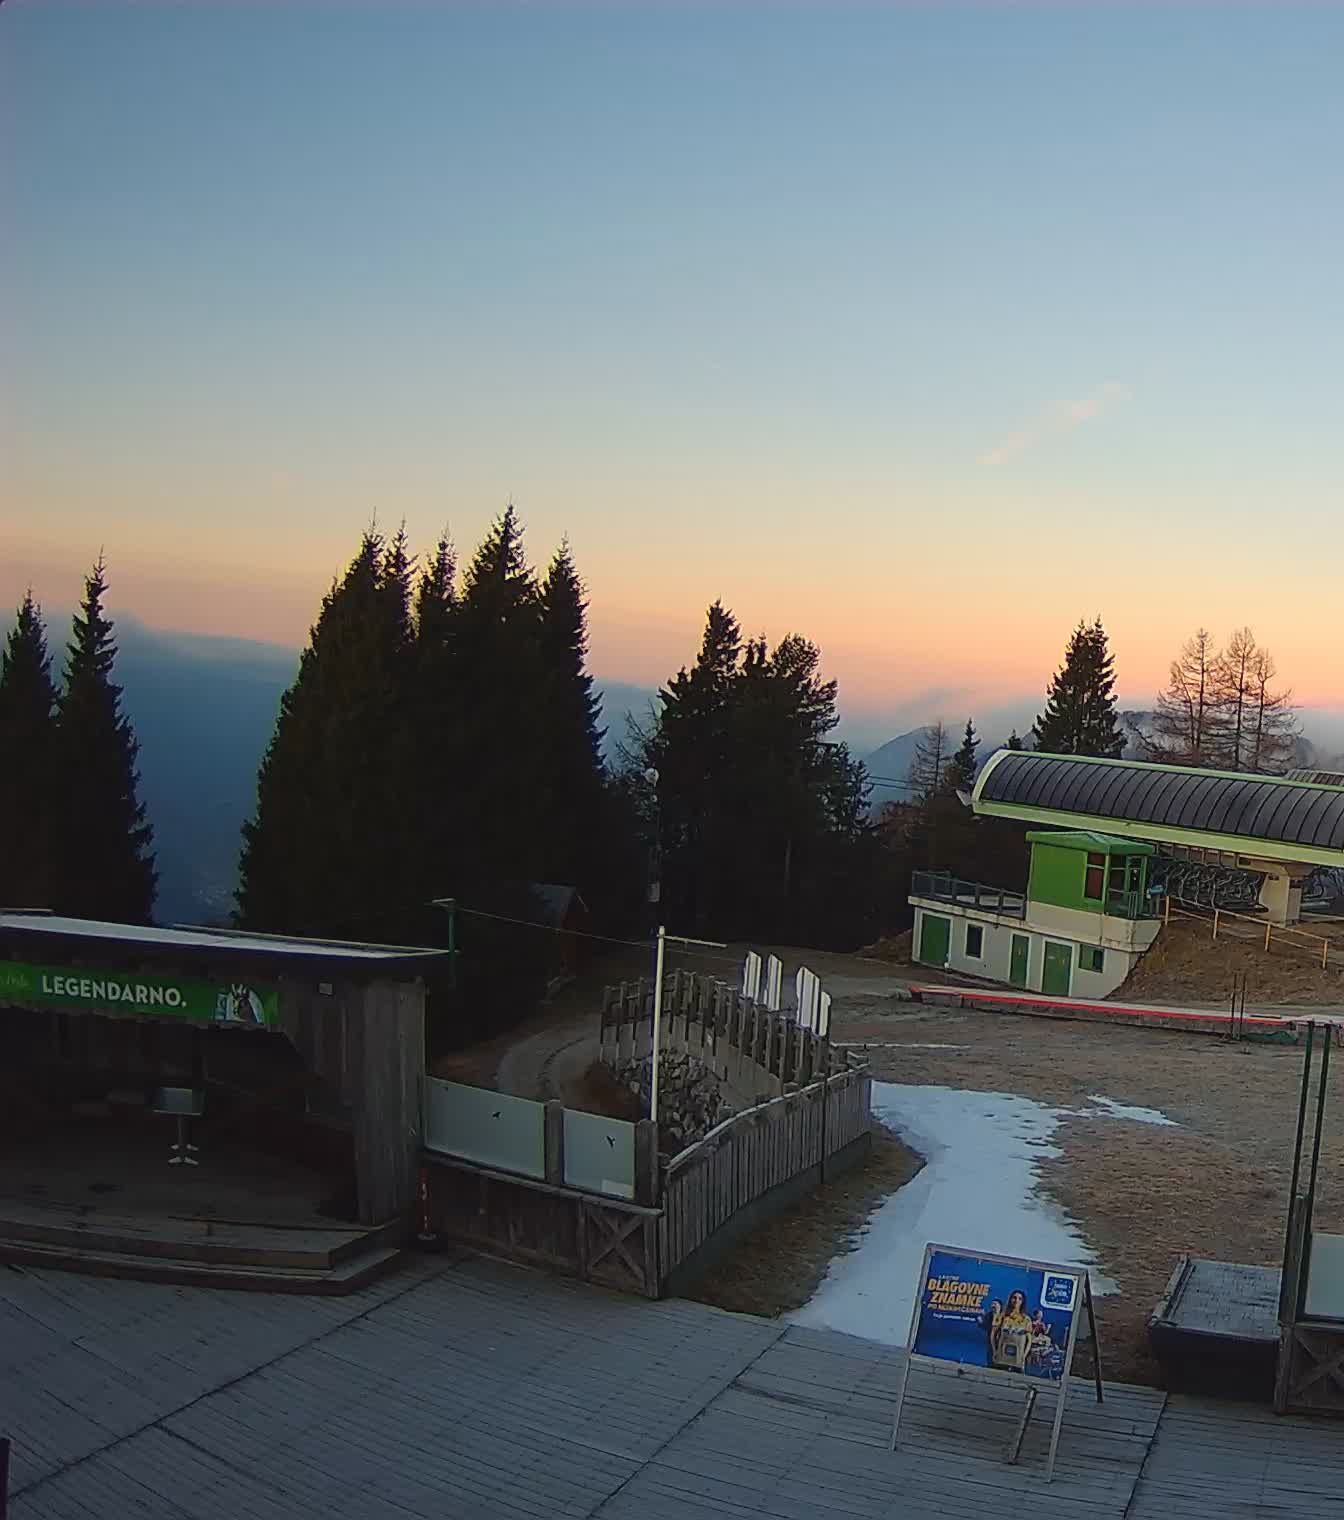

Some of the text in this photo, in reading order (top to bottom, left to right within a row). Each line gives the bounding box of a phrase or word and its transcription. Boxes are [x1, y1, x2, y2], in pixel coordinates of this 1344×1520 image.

[42, 974, 188, 1008] LEGENDARNO.
[927, 1278, 991, 1297] BLAGOVNE
[930, 1291, 984, 1308] ZNAMKE
